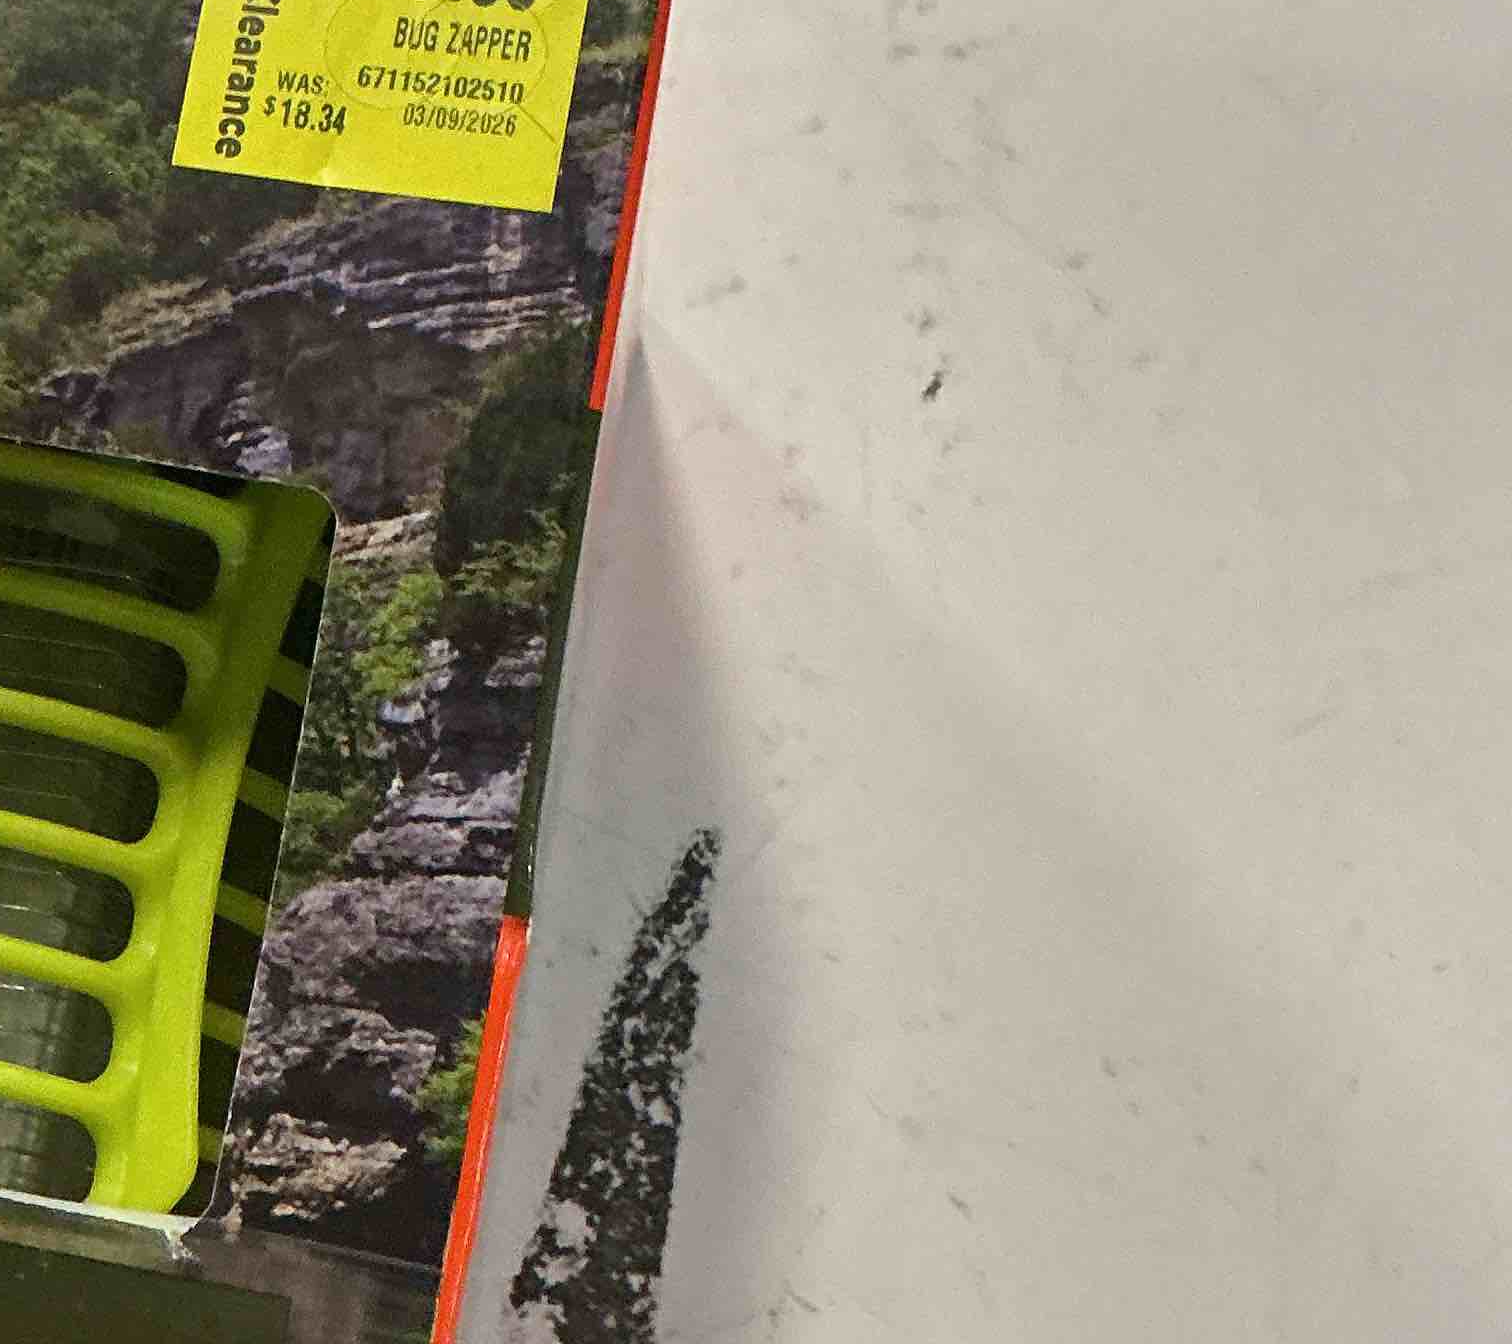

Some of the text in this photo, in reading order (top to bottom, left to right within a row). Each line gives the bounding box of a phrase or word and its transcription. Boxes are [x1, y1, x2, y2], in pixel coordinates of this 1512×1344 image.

[392, 16, 532, 64] BUG ZAPPER
[277, 70, 330, 98] WAS:
[357, 63, 525, 105] 671152102510
[263, 94, 348, 137] $18.34
[402, 102, 518, 138] 03/09/2026
